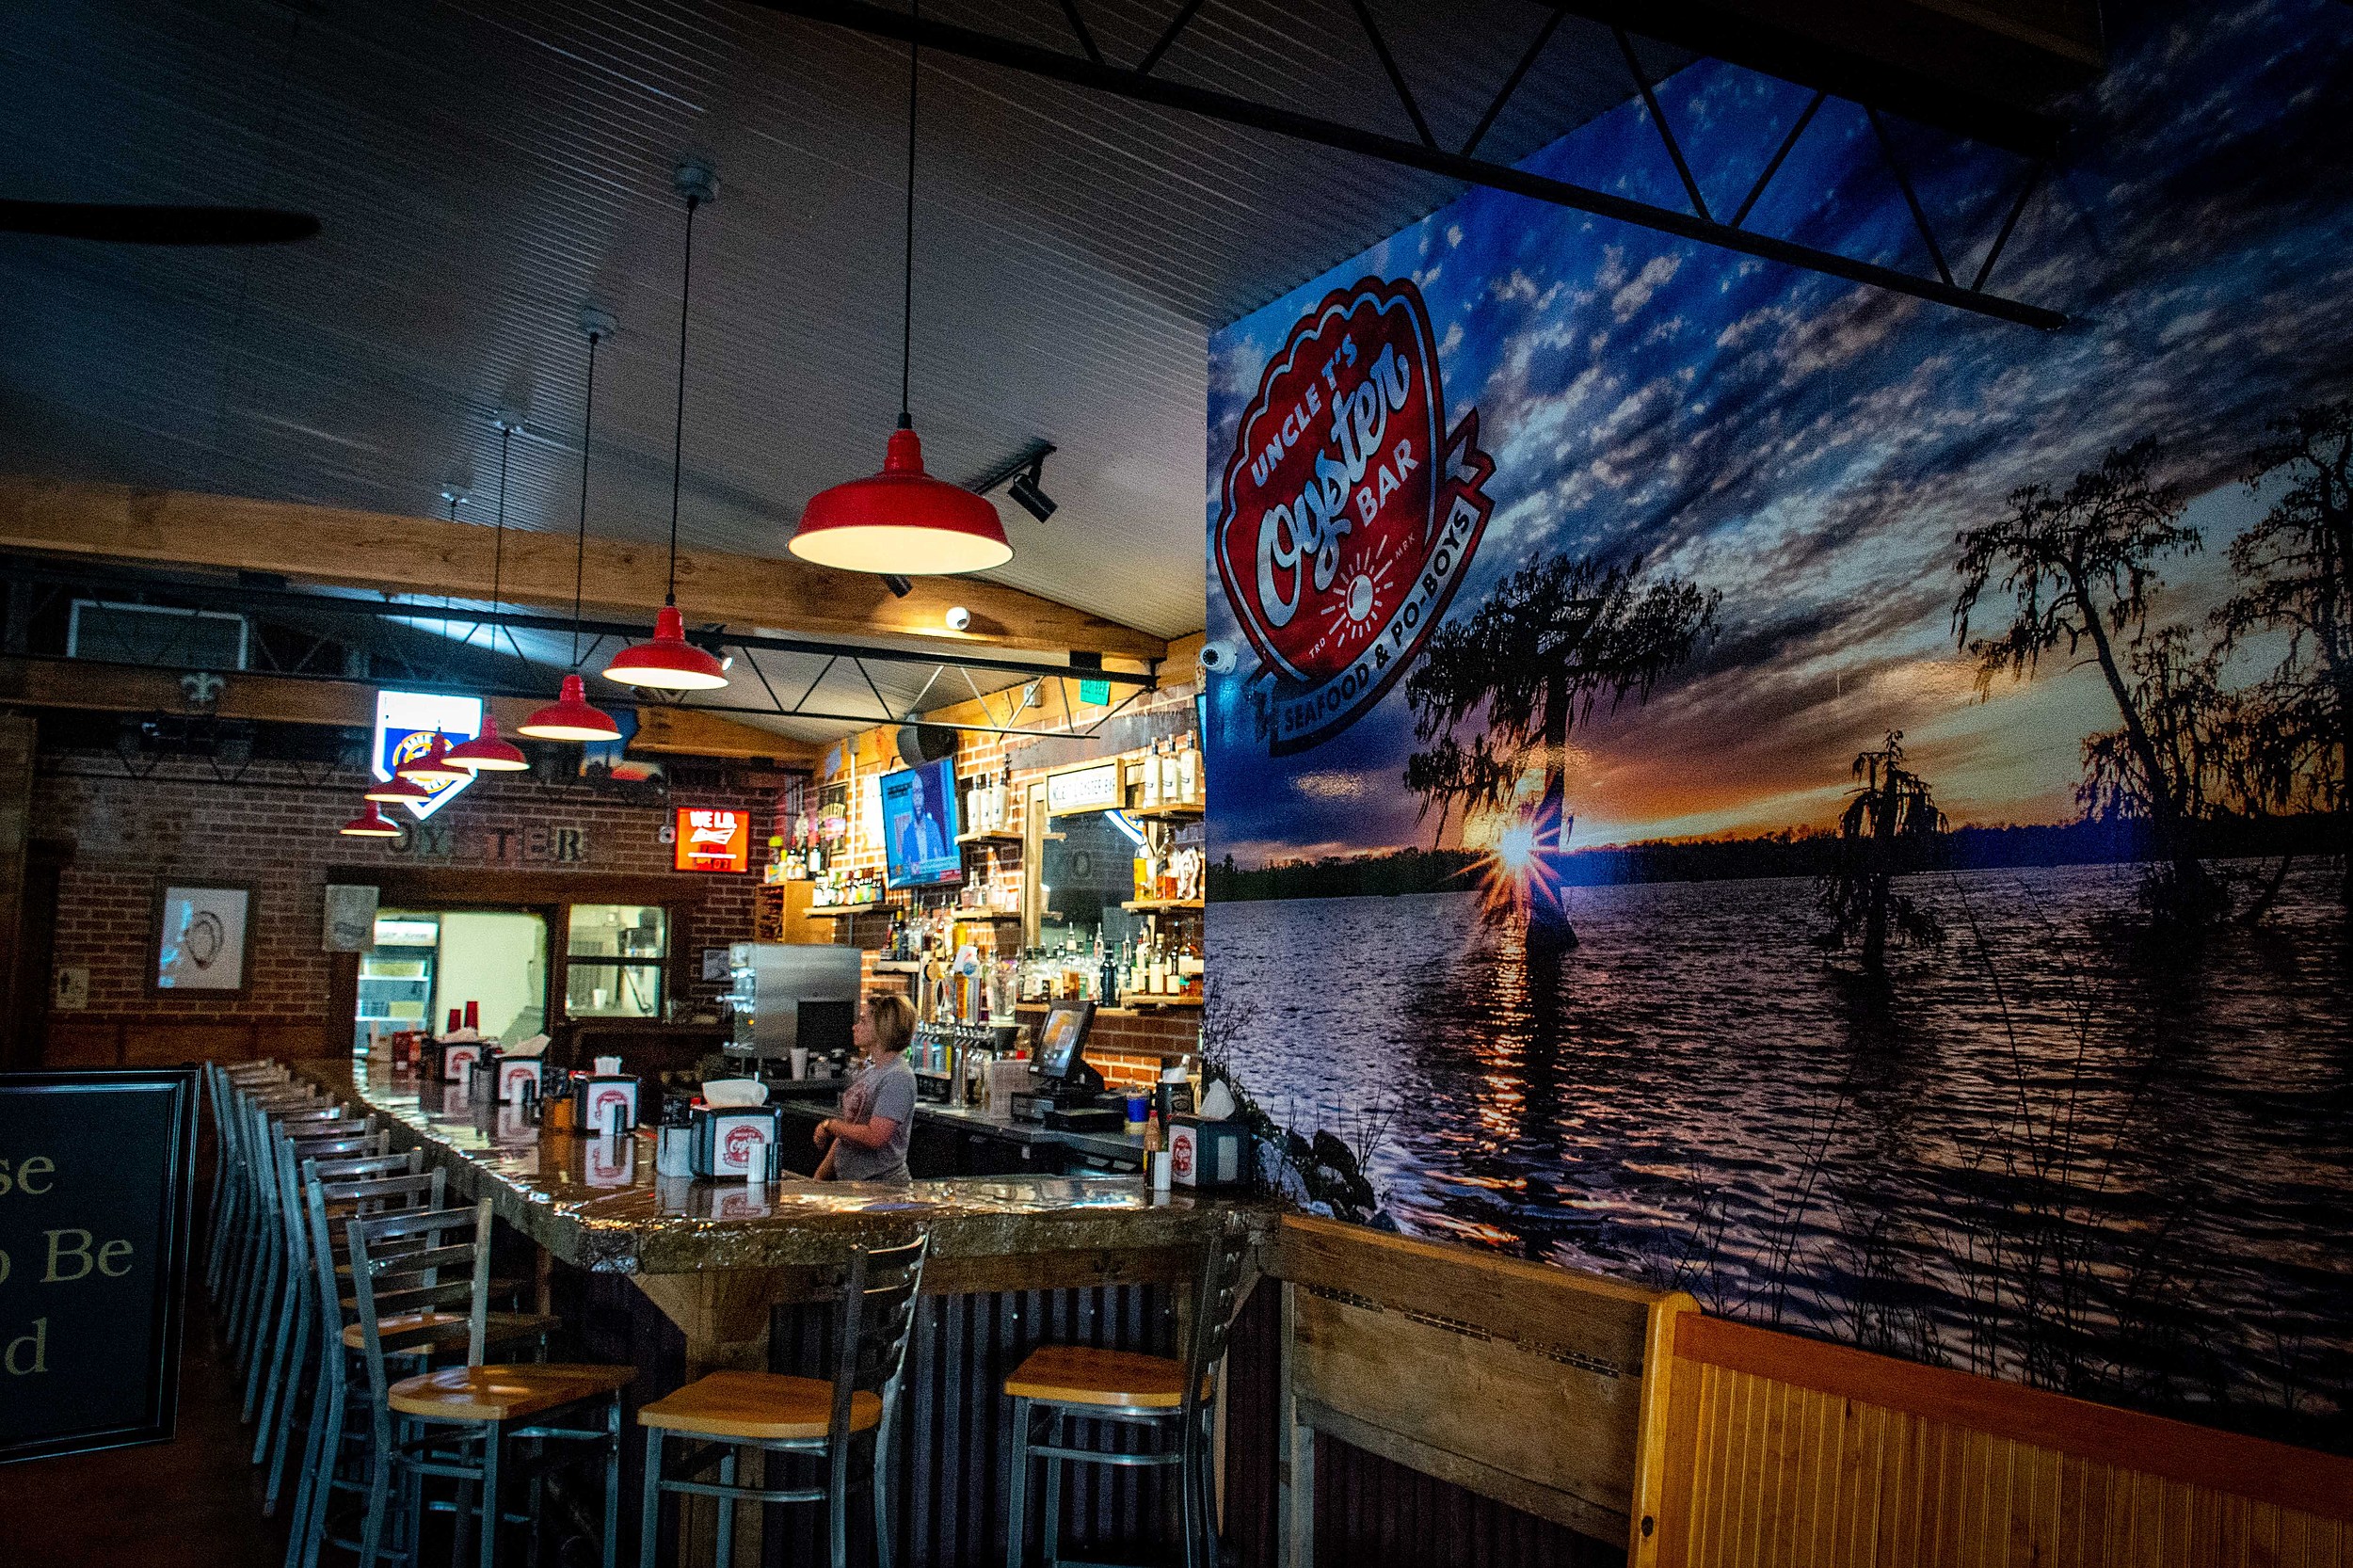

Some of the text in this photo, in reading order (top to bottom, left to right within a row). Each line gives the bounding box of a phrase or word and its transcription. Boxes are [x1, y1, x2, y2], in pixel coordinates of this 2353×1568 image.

[1251, 333, 1357, 488] UNCLE T'S
[1257, 343, 1410, 627] Oyster
[1356, 439, 1418, 527] BAR
[1285, 509, 1469, 732] SEAFOOD & PO-BOYS
[388, 823, 582, 861] OYTER
[689, 810, 713, 828] WE
[40, 1227, 134, 1283] Be
